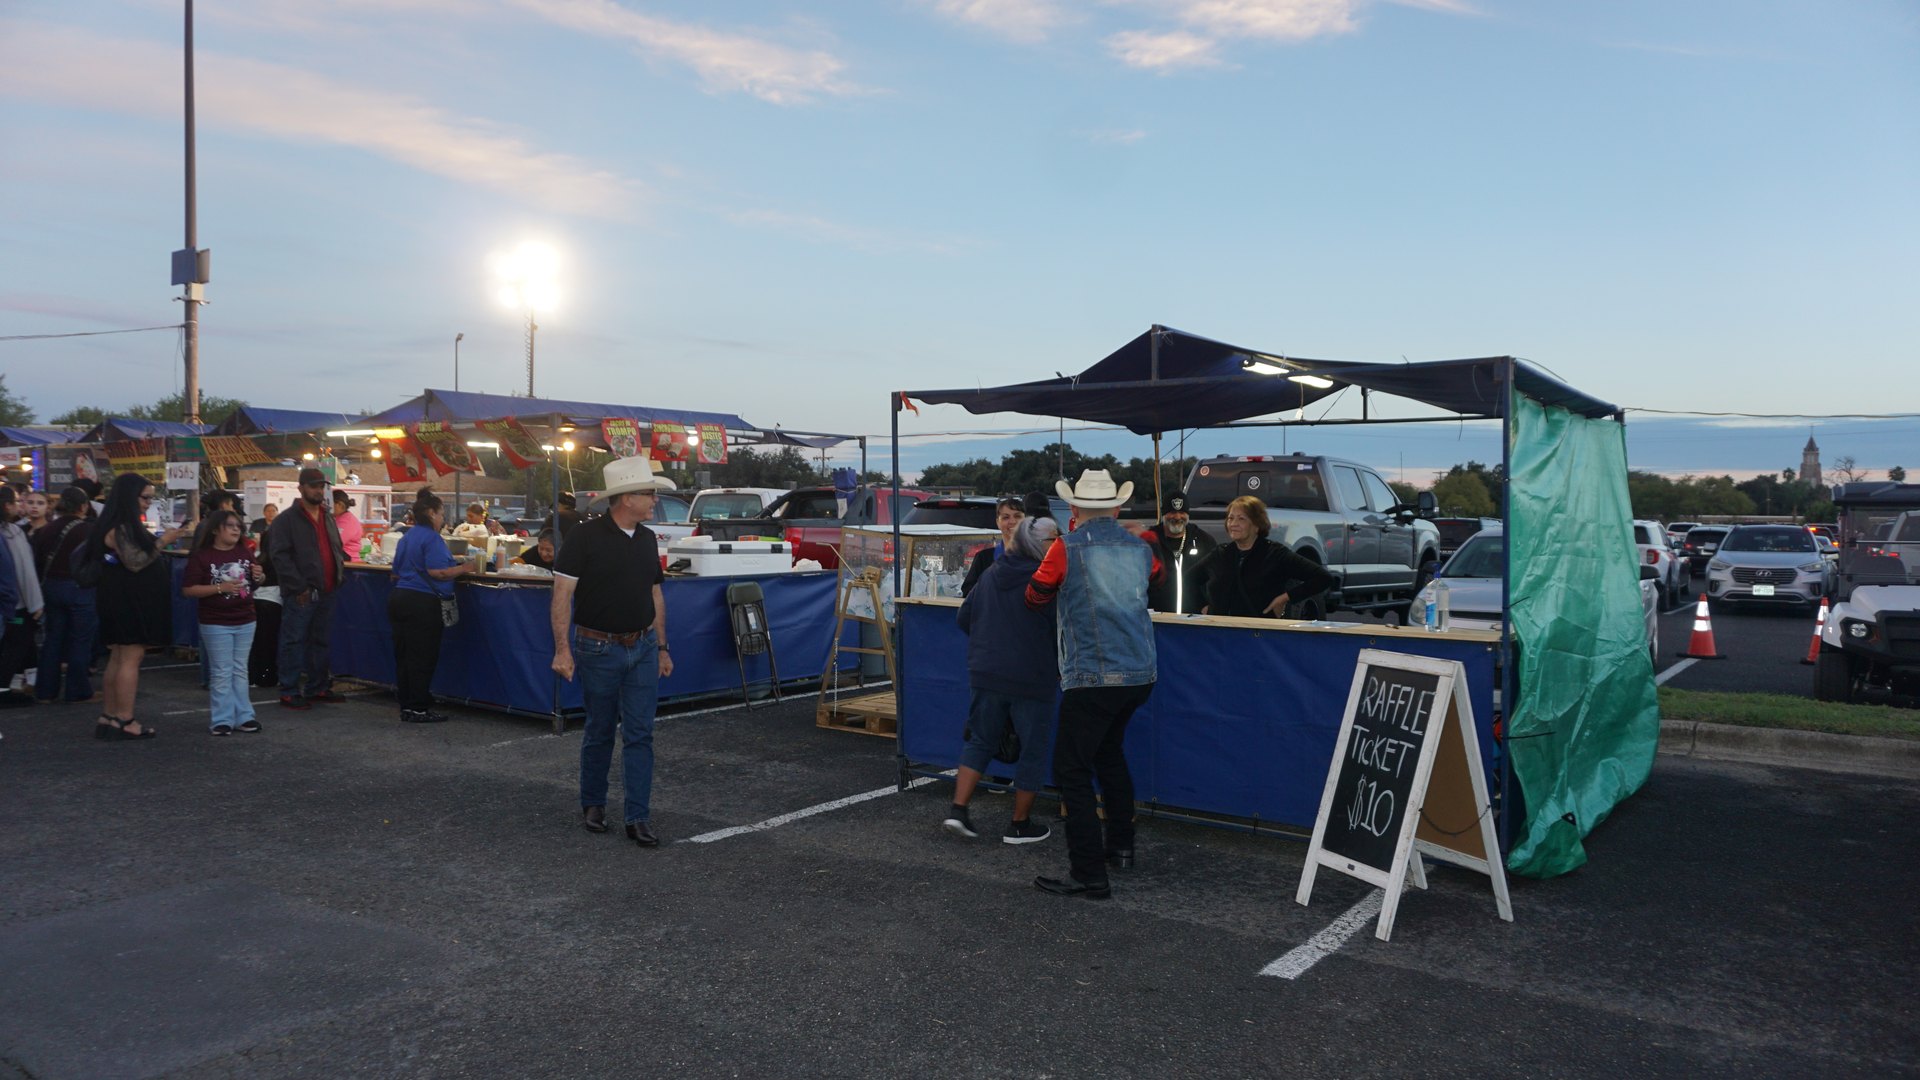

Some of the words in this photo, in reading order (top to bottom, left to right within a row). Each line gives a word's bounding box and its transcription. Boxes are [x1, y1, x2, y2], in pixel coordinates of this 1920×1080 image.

[606, 427, 637, 437] TROMPO
[1361, 675, 1437, 736] RAFFLE
[1351, 724, 1416, 779] TICKET
[1347, 773, 1395, 837] $10
